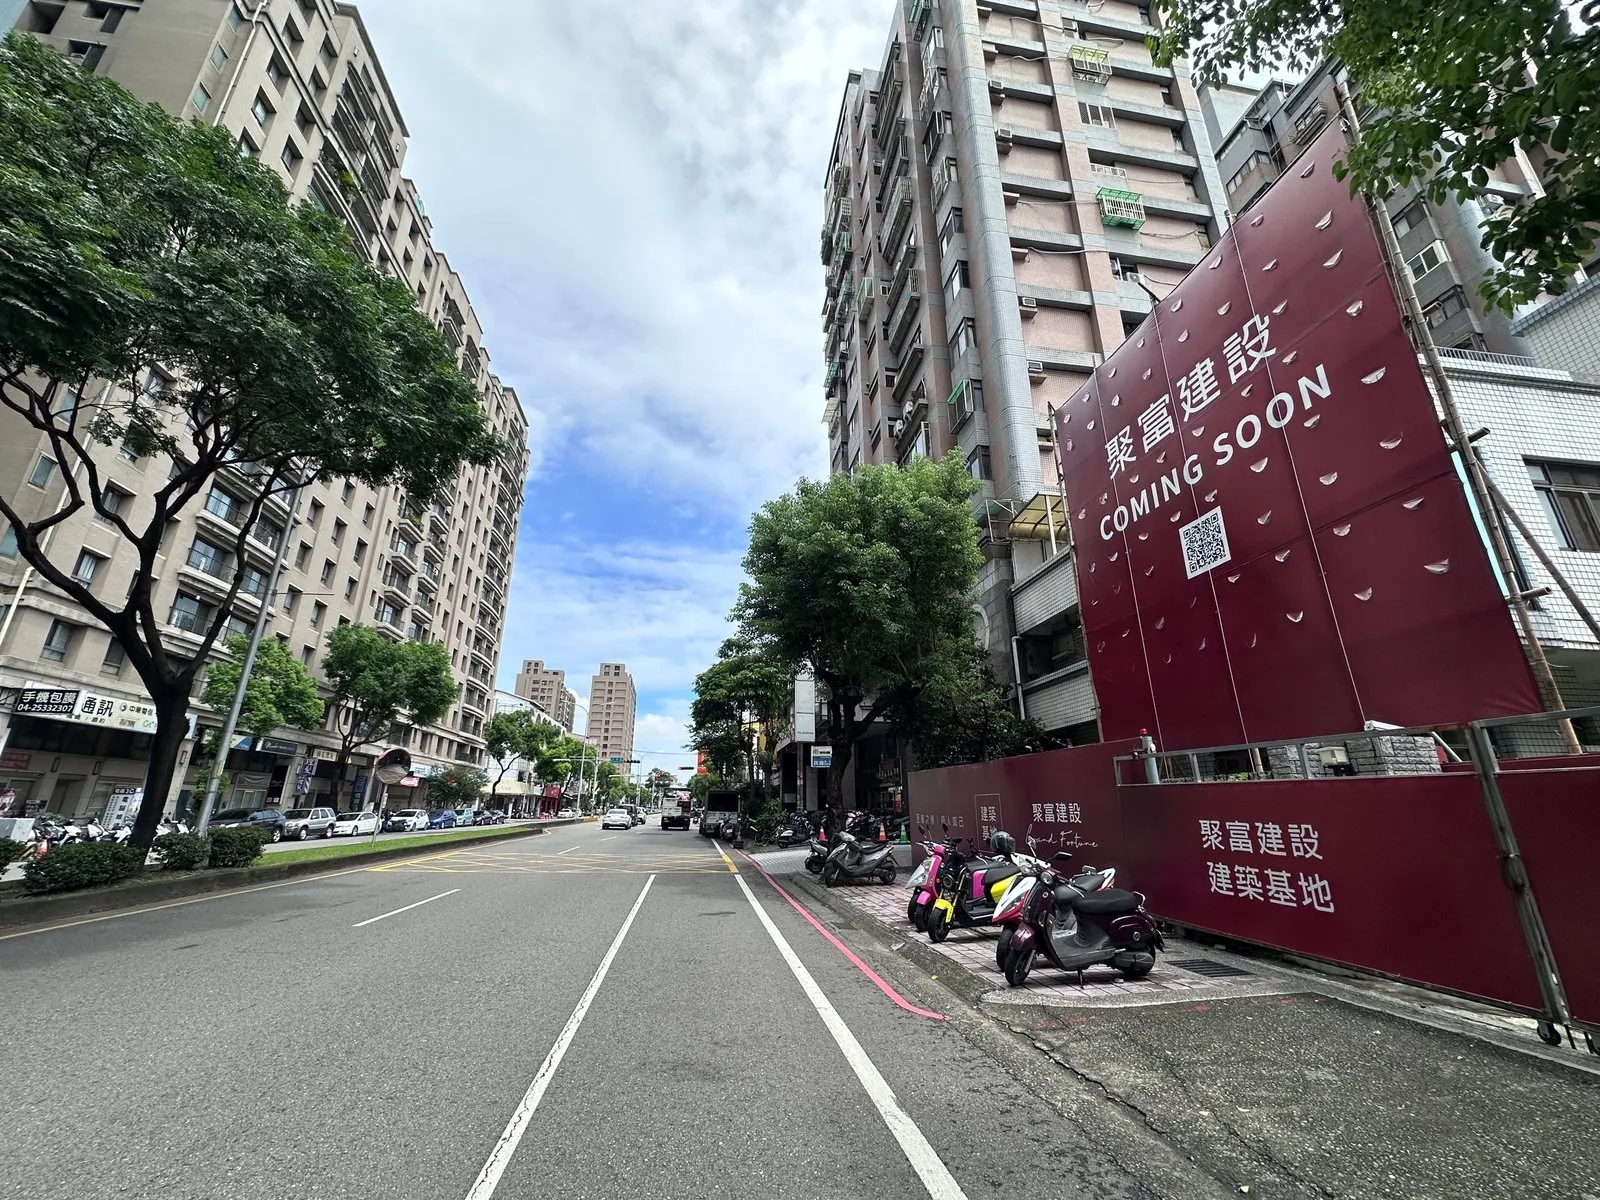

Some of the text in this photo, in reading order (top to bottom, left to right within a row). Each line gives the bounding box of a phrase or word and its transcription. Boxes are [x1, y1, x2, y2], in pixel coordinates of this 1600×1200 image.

[1104, 313, 1278, 480] 聚富建設
[1099, 363, 1332, 542] COMING SOON
[17, 703, 74, 712] 04-25332307
[22, 691, 77, 704] 手機包膜
[81, 696, 115, 718] 通訊
[1031, 802, 1083, 824] 聚富建設
[1060, 829, 1099, 849] Fortune
[1198, 819, 1324, 861] 聚富建設
[1206, 861, 1336, 914] 建築基地
